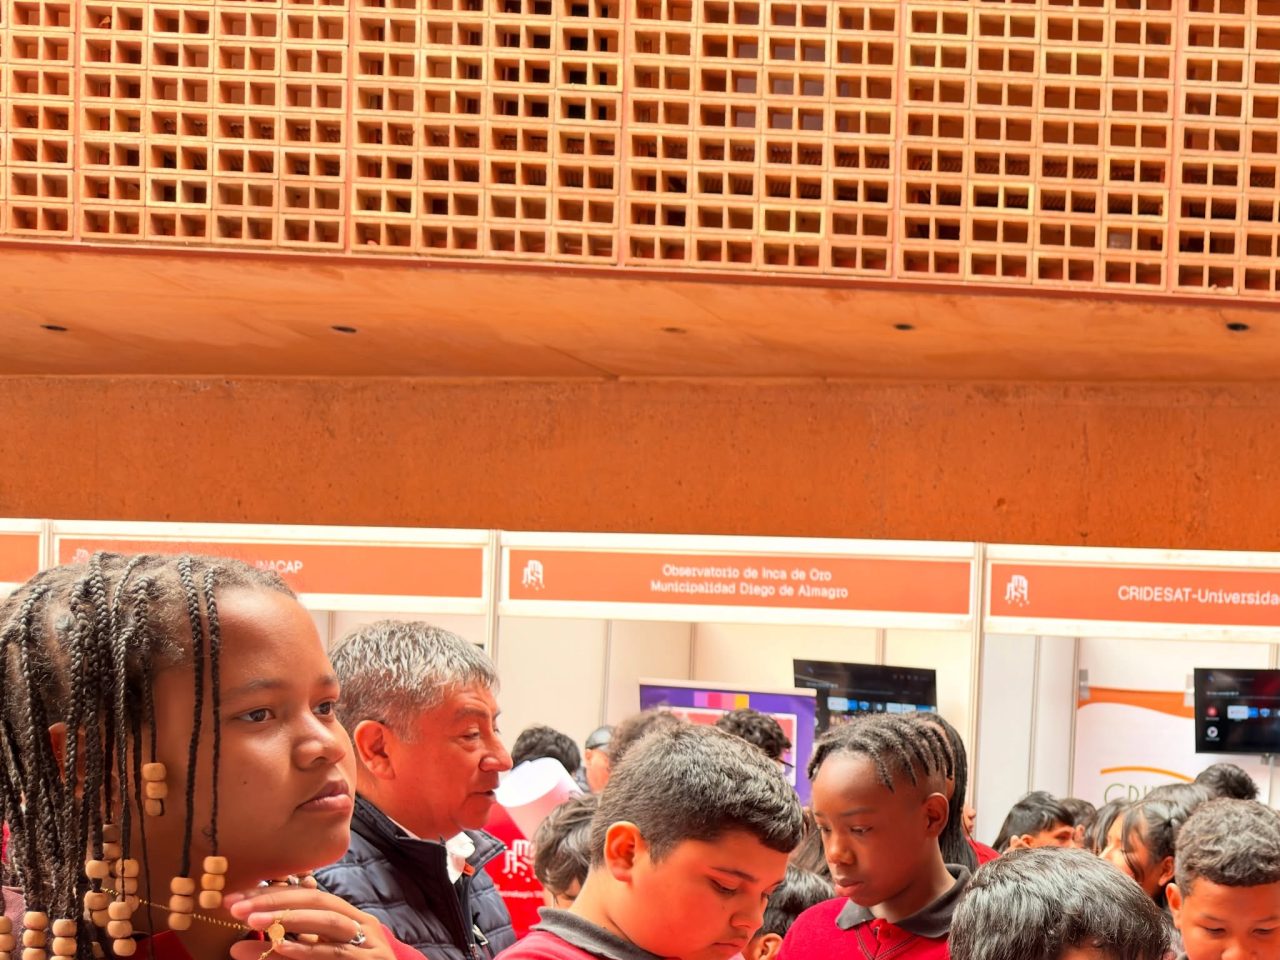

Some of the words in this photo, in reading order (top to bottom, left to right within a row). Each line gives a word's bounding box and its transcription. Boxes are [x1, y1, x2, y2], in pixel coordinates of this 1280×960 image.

[662, 563, 740, 579] Observatorio
[743, 566, 759, 580] de
[762, 567, 787, 581] Inca
[791, 567, 806, 581] de
[809, 568, 832, 581] Oro
[651, 580, 736, 594] Municipalidad
[740, 582, 775, 597] Diego
[779, 584, 795, 597] de
[798, 585, 848, 599] Almagro
